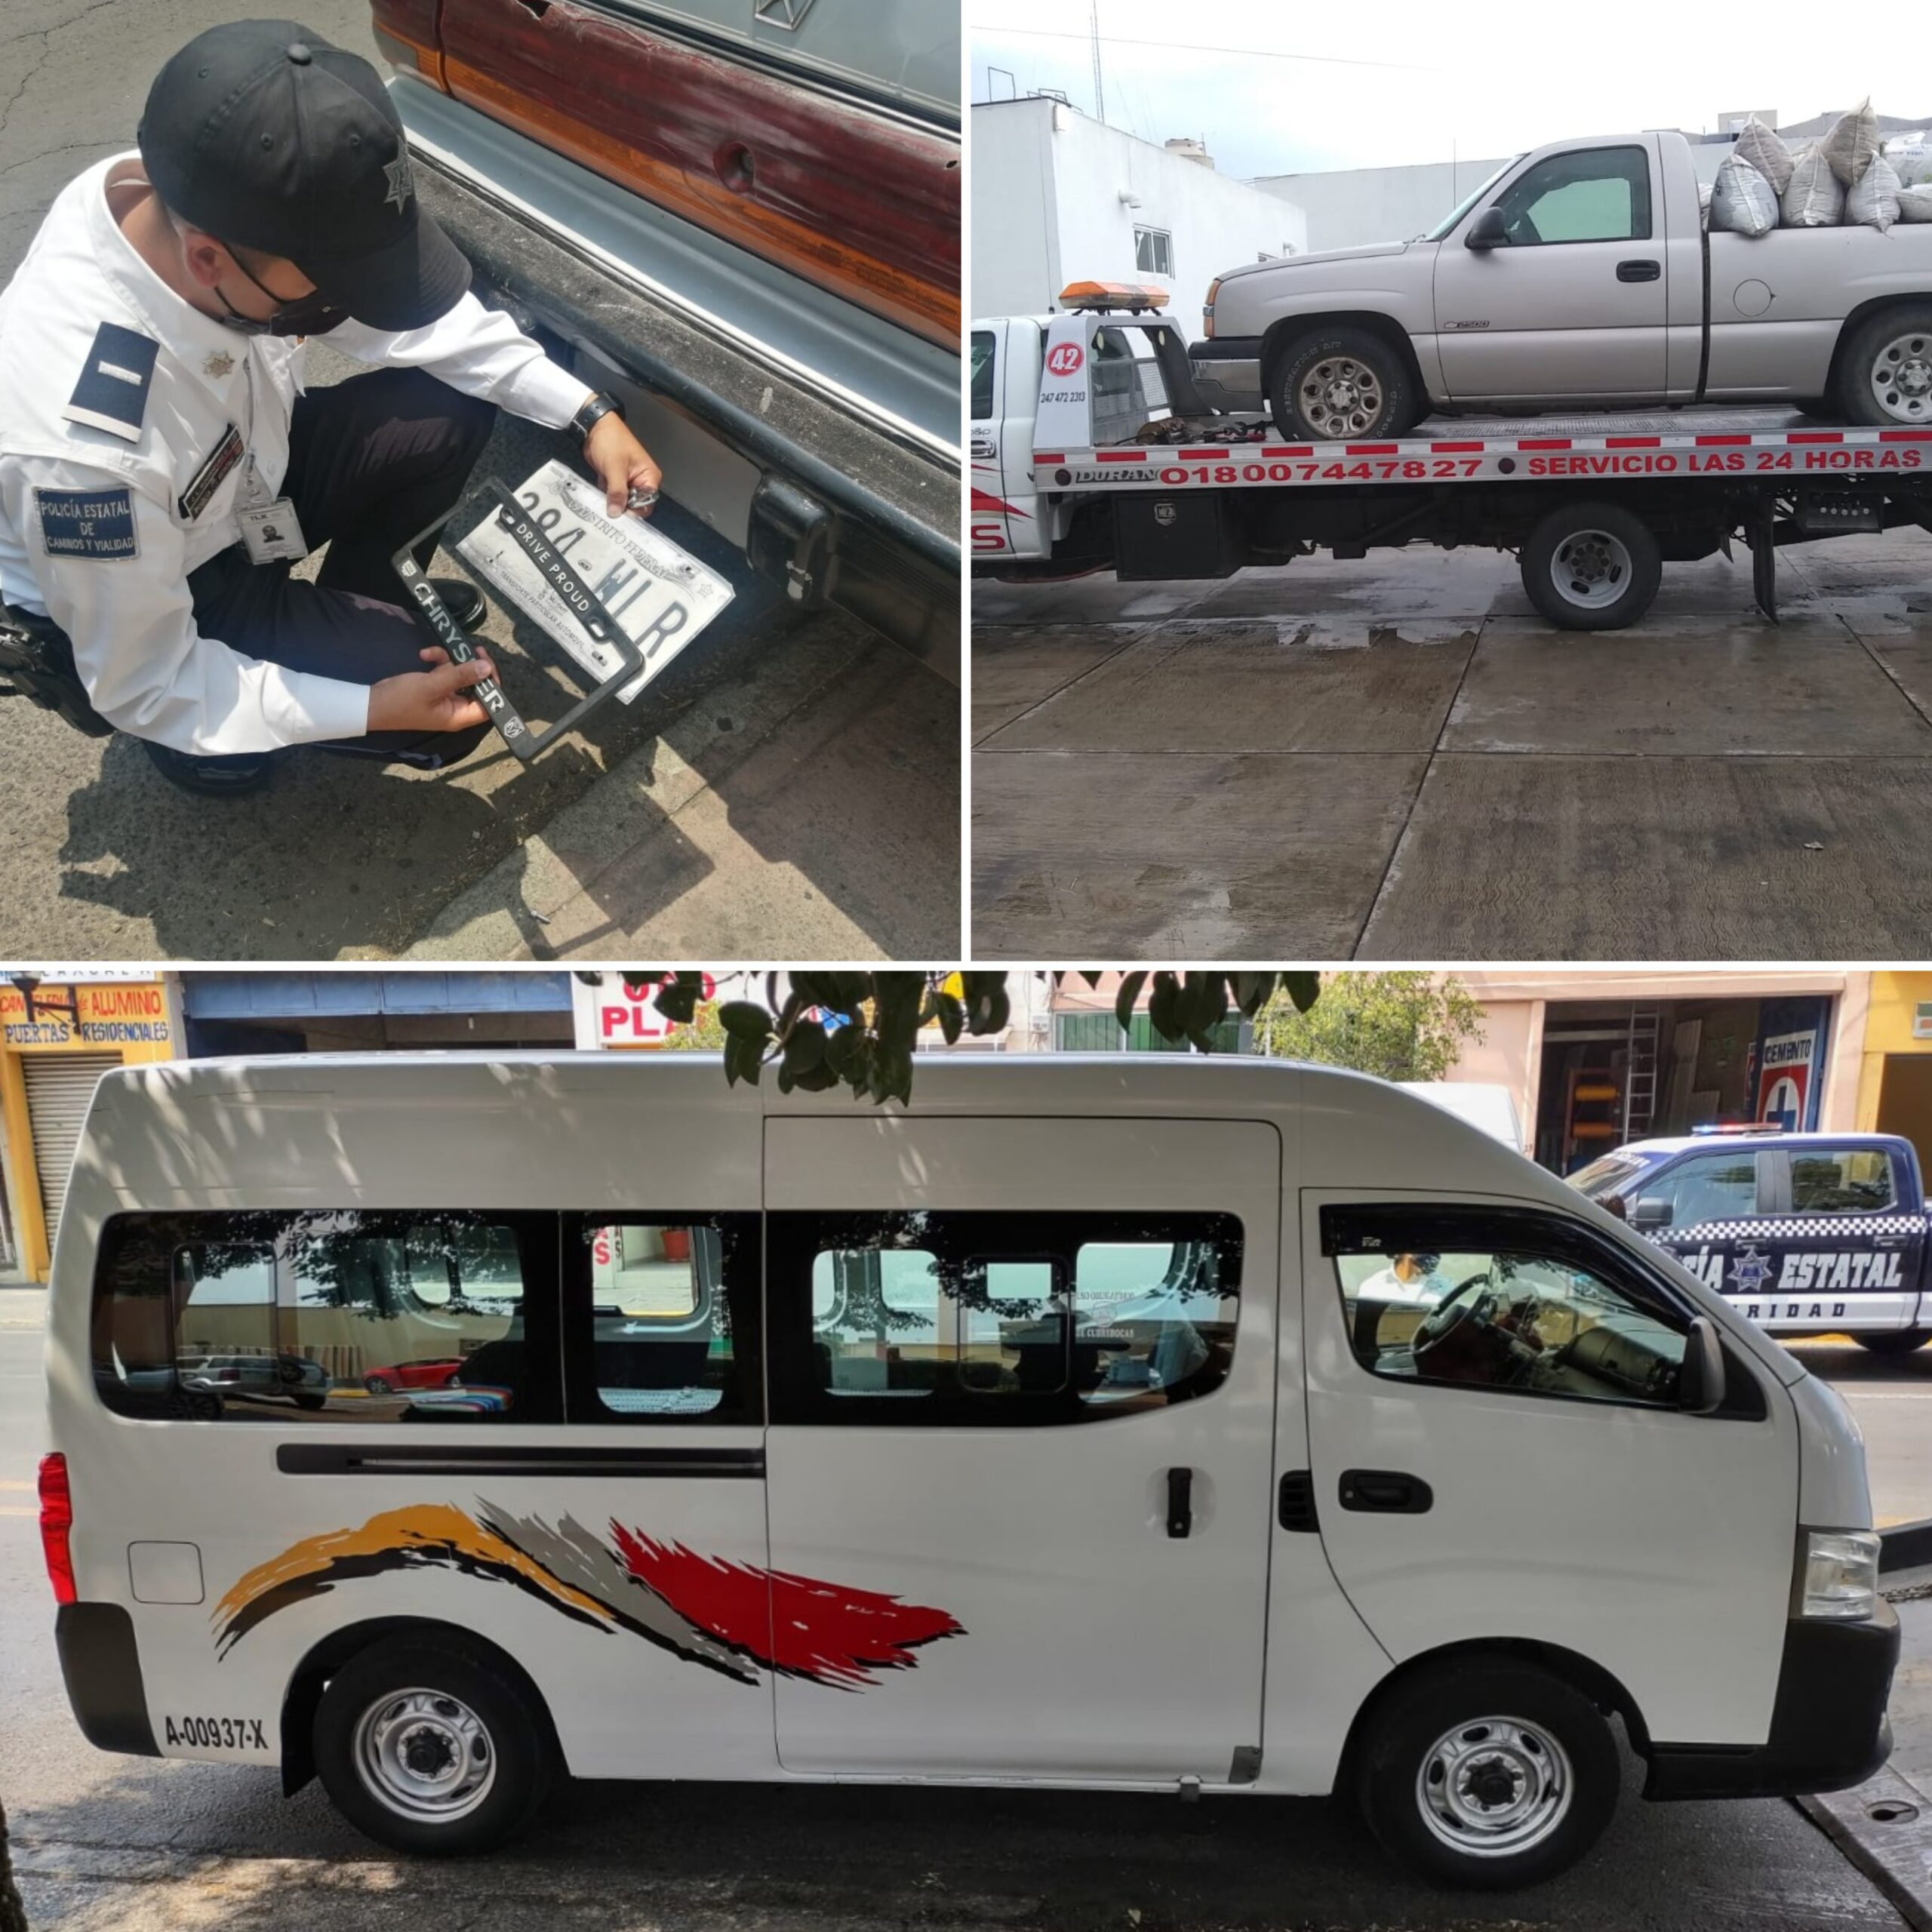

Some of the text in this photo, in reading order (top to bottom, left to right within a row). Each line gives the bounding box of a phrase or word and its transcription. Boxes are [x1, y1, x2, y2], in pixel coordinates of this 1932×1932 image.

[1051, 348, 1079, 370] 42
[1041, 392, 1054, 403] 247
[1055, 392, 1068, 402] 472
[1528, 449, 1921, 475] SERVICIO LAS 24 HORAS
[41, 499, 130, 518] POLICÍA ESTATAL
[80, 522, 94, 536] DE
[47, 537, 134, 551] CAMINOS Y VIALIDAD
[516, 523, 551, 563] DRIVE
[549, 564, 589, 612] PROUD
[500, 571, 529, 598] TRANSPORTE
[528, 595, 558, 625] PARTICULAR
[414, 583, 506, 712] CHRYSER
[5, 1021, 168, 1044] PUERTAS RESIDENCIALES
[1777, 1253, 1903, 1289] ESTATAL
[1734, 1303, 1846, 1318] RIDAD
[165, 1715, 269, 1749] A-00937-X
